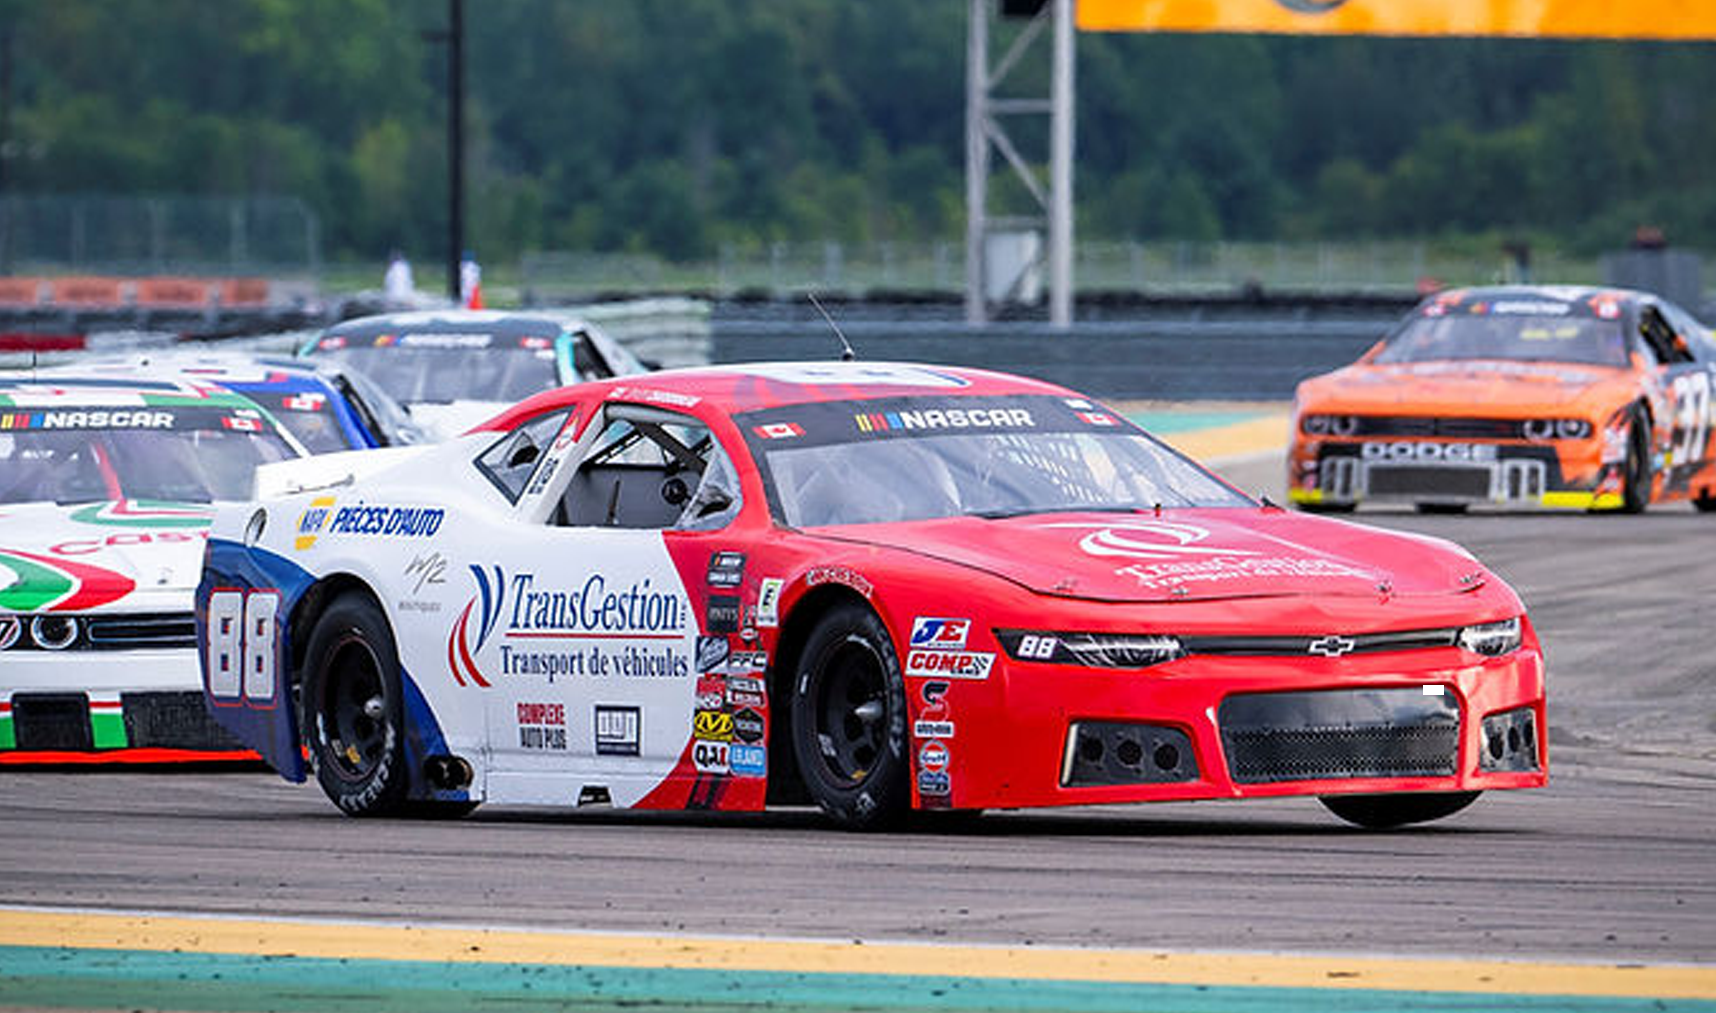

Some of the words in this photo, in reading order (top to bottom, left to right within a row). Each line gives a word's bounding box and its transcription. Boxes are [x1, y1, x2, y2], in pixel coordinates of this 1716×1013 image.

[43, 412, 174, 428] NASCAR
[902, 409, 1035, 430] NASCAR
[1362, 442, 1498, 460] DODGE
[329, 500, 389, 534] PIÈCES
[510, 574, 679, 631] TransGestion
[911, 620, 966, 644] JE
[207, 590, 278, 702] 88
[1018, 634, 1057, 659] 88
[500, 645, 584, 683] Transport
[587, 647, 609, 676] de
[611, 646, 689, 678] véhicules
[910, 652, 972, 672] COMP
[520, 727, 543, 749] AUTO
[545, 728, 566, 750] PLUS
